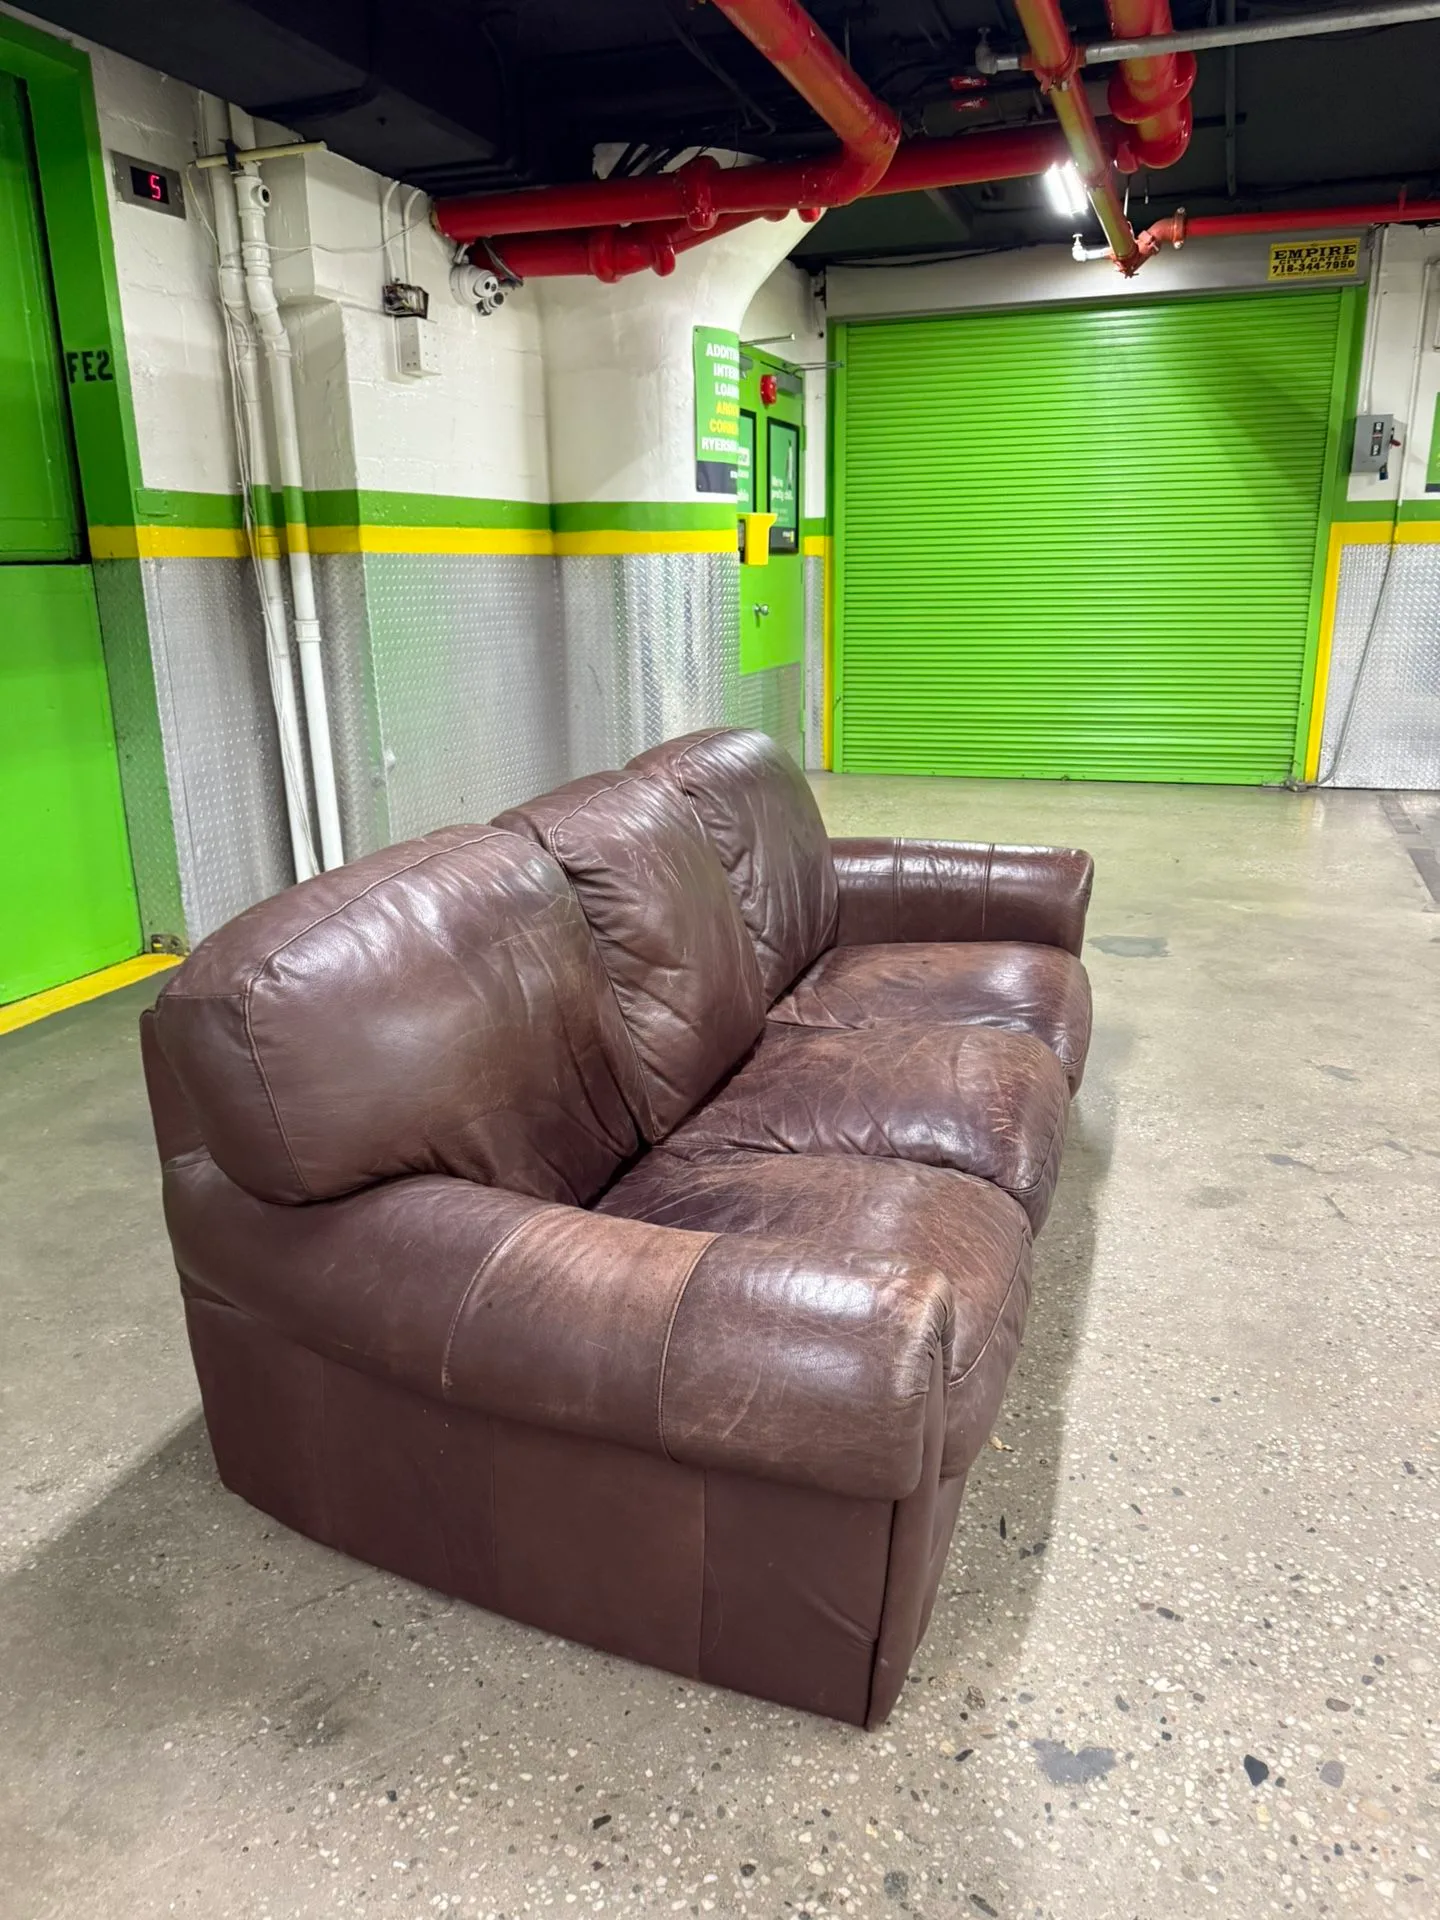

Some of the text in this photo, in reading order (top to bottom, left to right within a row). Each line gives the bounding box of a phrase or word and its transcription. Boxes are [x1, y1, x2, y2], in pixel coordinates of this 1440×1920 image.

[150, 174, 162, 200] 5
[1273, 244, 1357, 260] EMPIRE
[1279, 255, 1349, 265] CITY GATES
[67, 350, 114, 384] FE2
